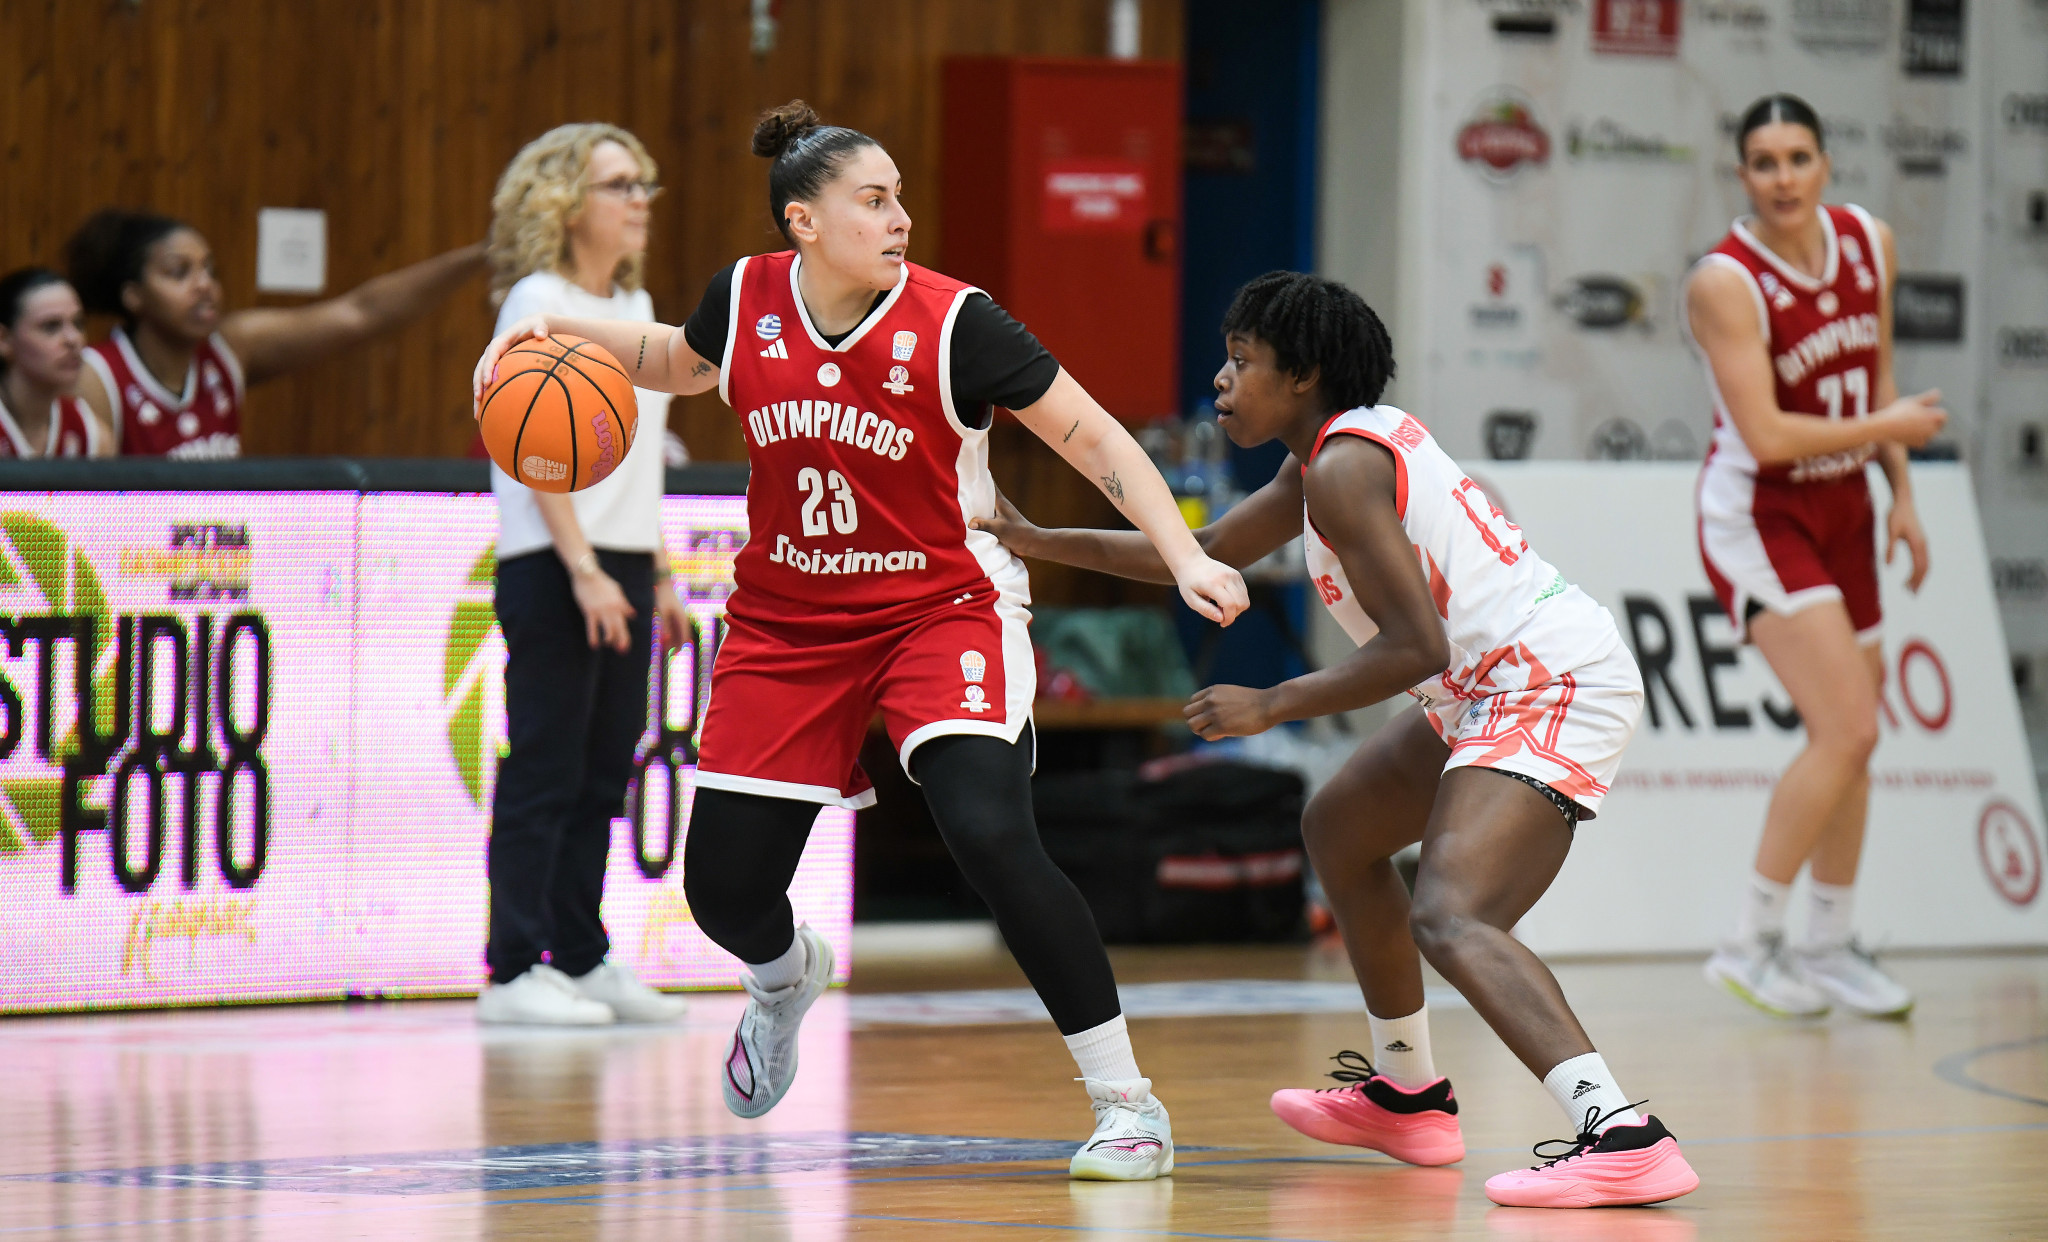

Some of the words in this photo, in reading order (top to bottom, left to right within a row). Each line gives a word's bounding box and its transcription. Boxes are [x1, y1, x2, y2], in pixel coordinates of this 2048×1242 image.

[748, 399, 914, 461] OLYMPIACOS
[797, 466, 858, 537] 23
[769, 533, 927, 575] Stoiximan
[61, 752, 270, 897] FOTO
